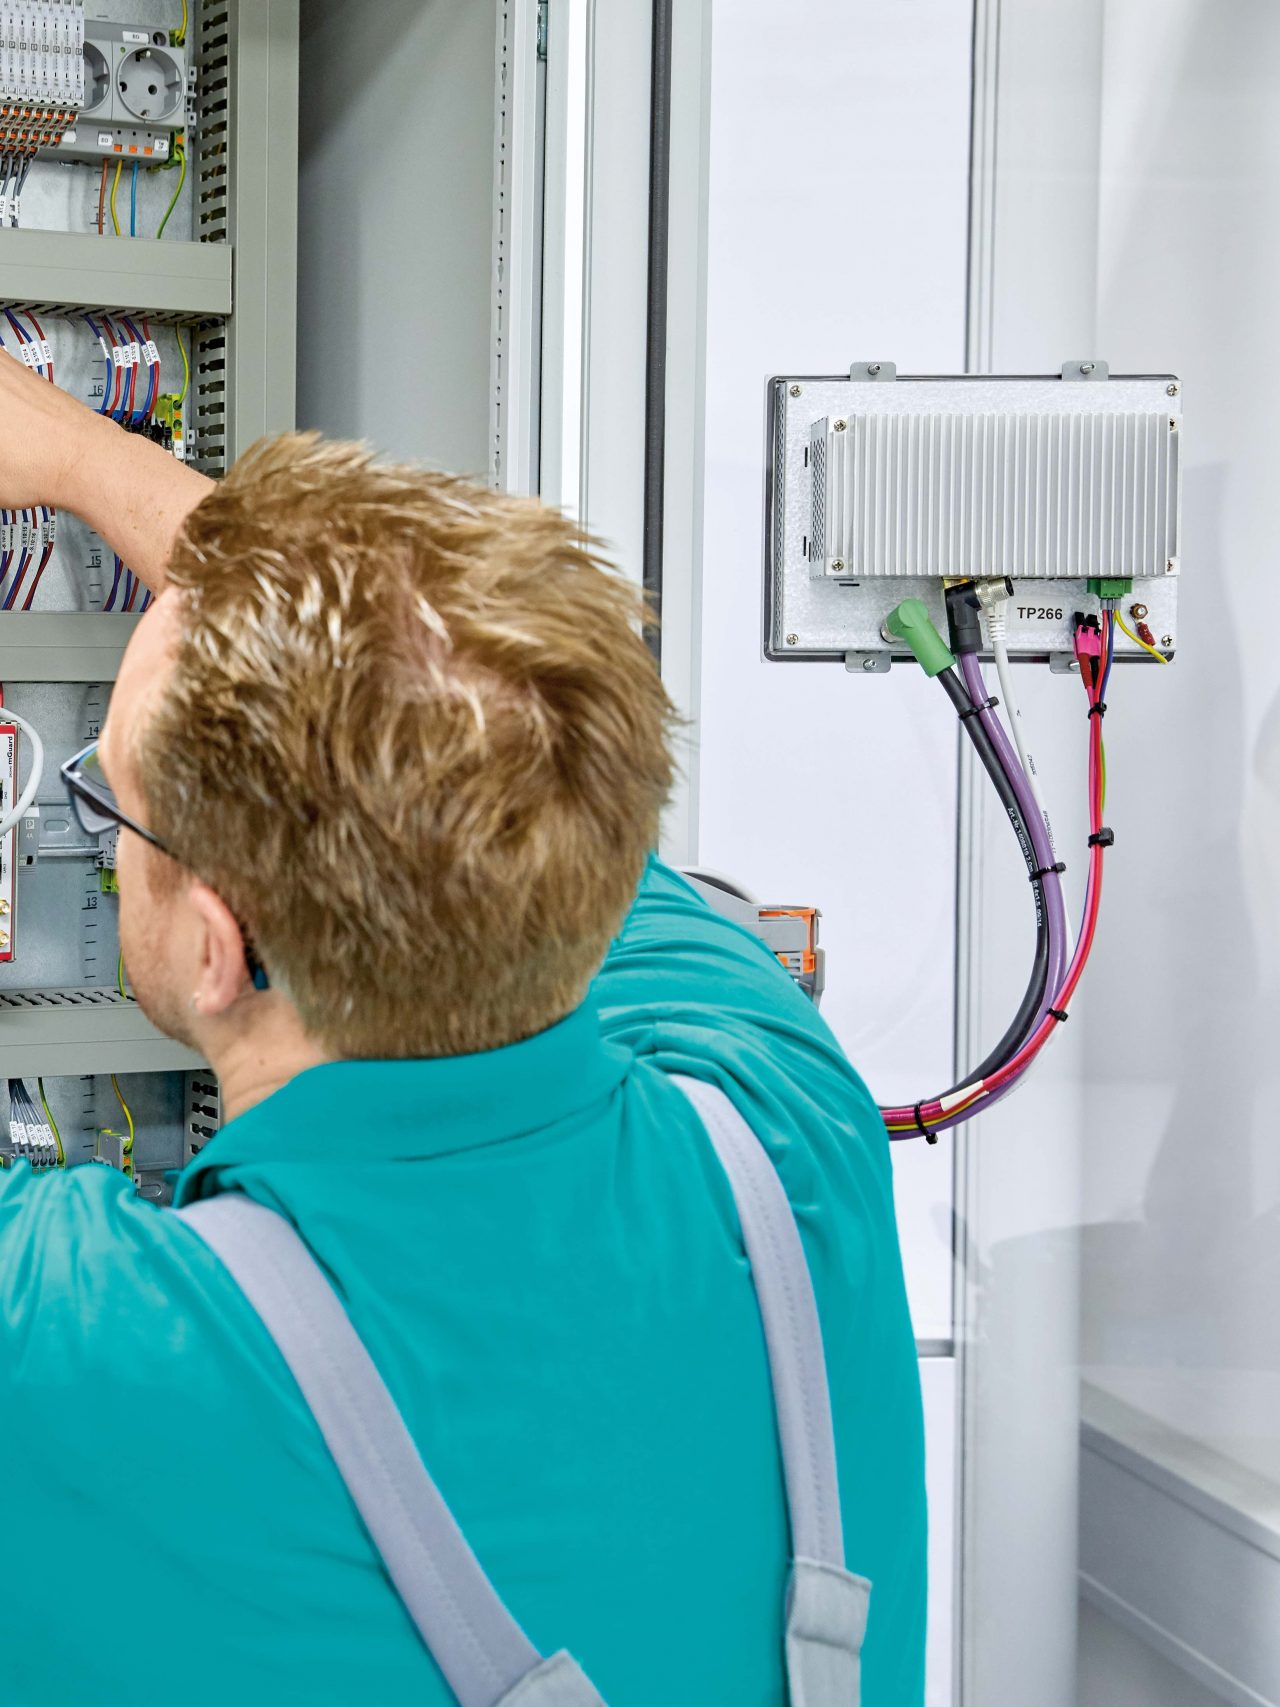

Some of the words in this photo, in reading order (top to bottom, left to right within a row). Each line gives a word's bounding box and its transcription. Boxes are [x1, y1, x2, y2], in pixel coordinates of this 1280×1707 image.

[93, 385, 104, 395] 16
[90, 555, 101, 565] 15
[1016, 607, 1063, 620] TP266
[89, 726, 99, 736] 14
[87, 897, 97, 907] 13
